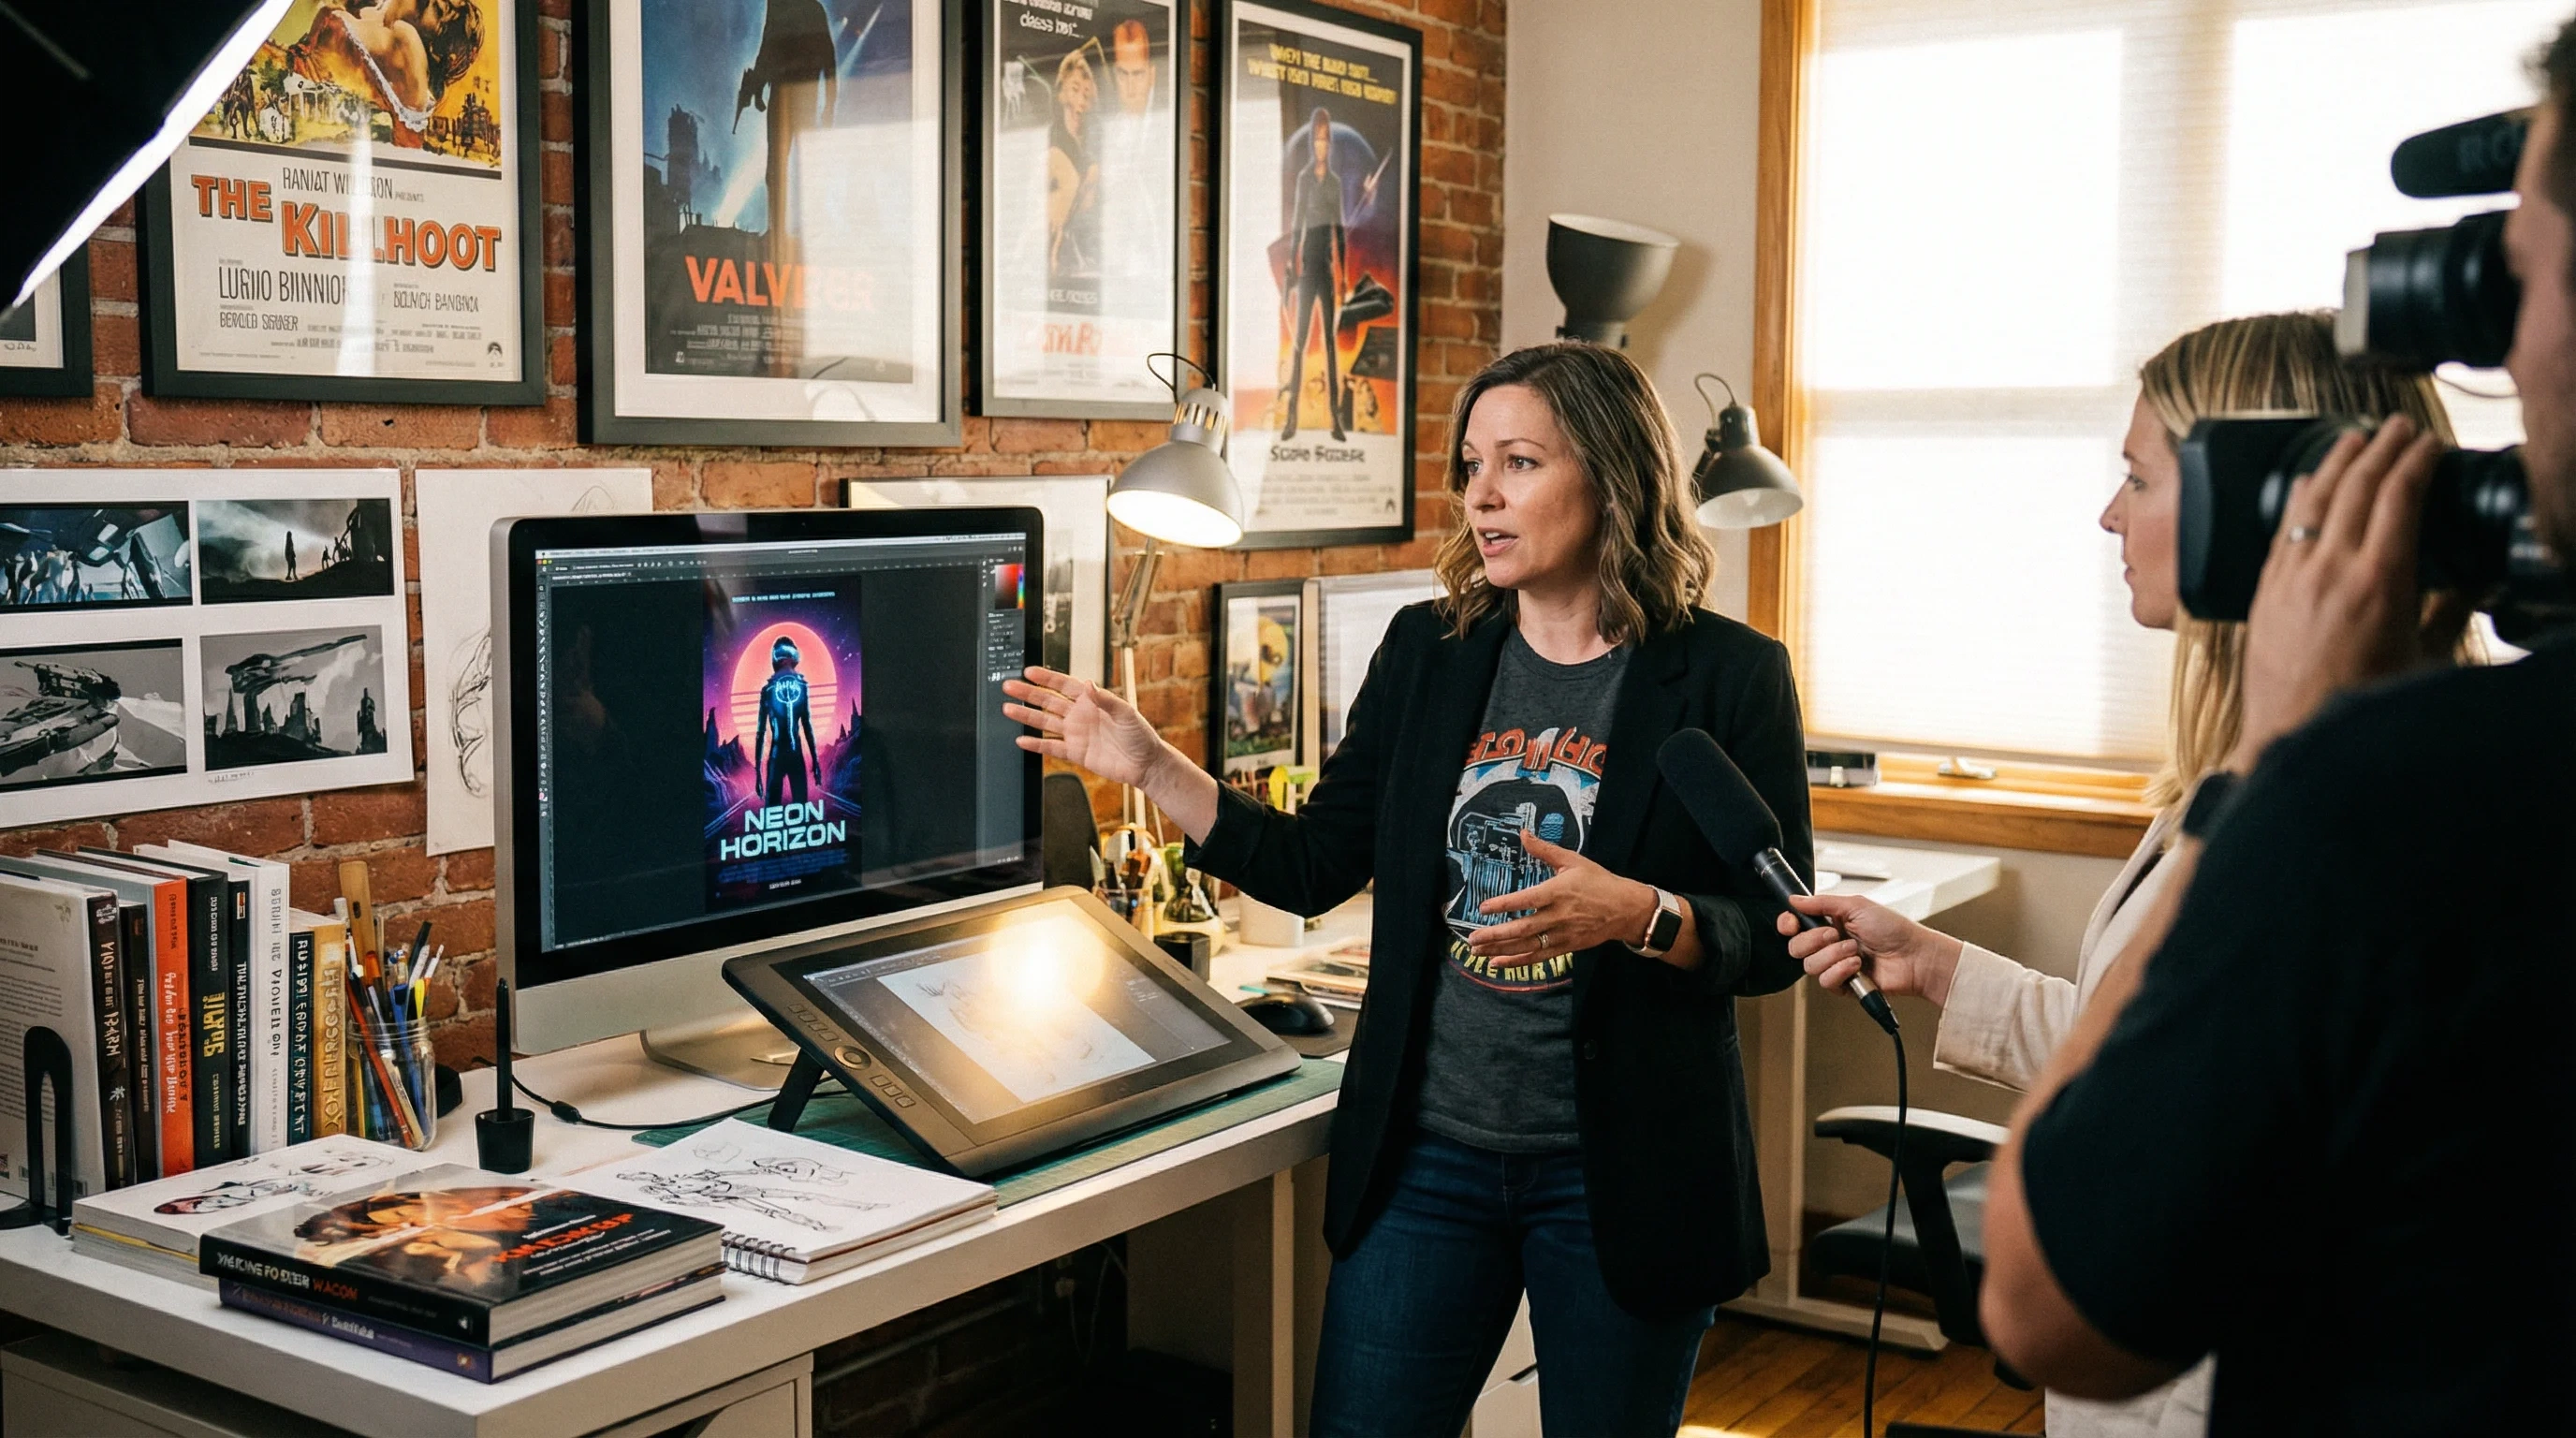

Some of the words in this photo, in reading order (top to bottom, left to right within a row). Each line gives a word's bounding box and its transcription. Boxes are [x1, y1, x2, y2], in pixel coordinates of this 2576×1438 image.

[191, 174, 273, 223] THE
[744, 799, 825, 832] NEON
[720, 820, 846, 861] HORIZON
